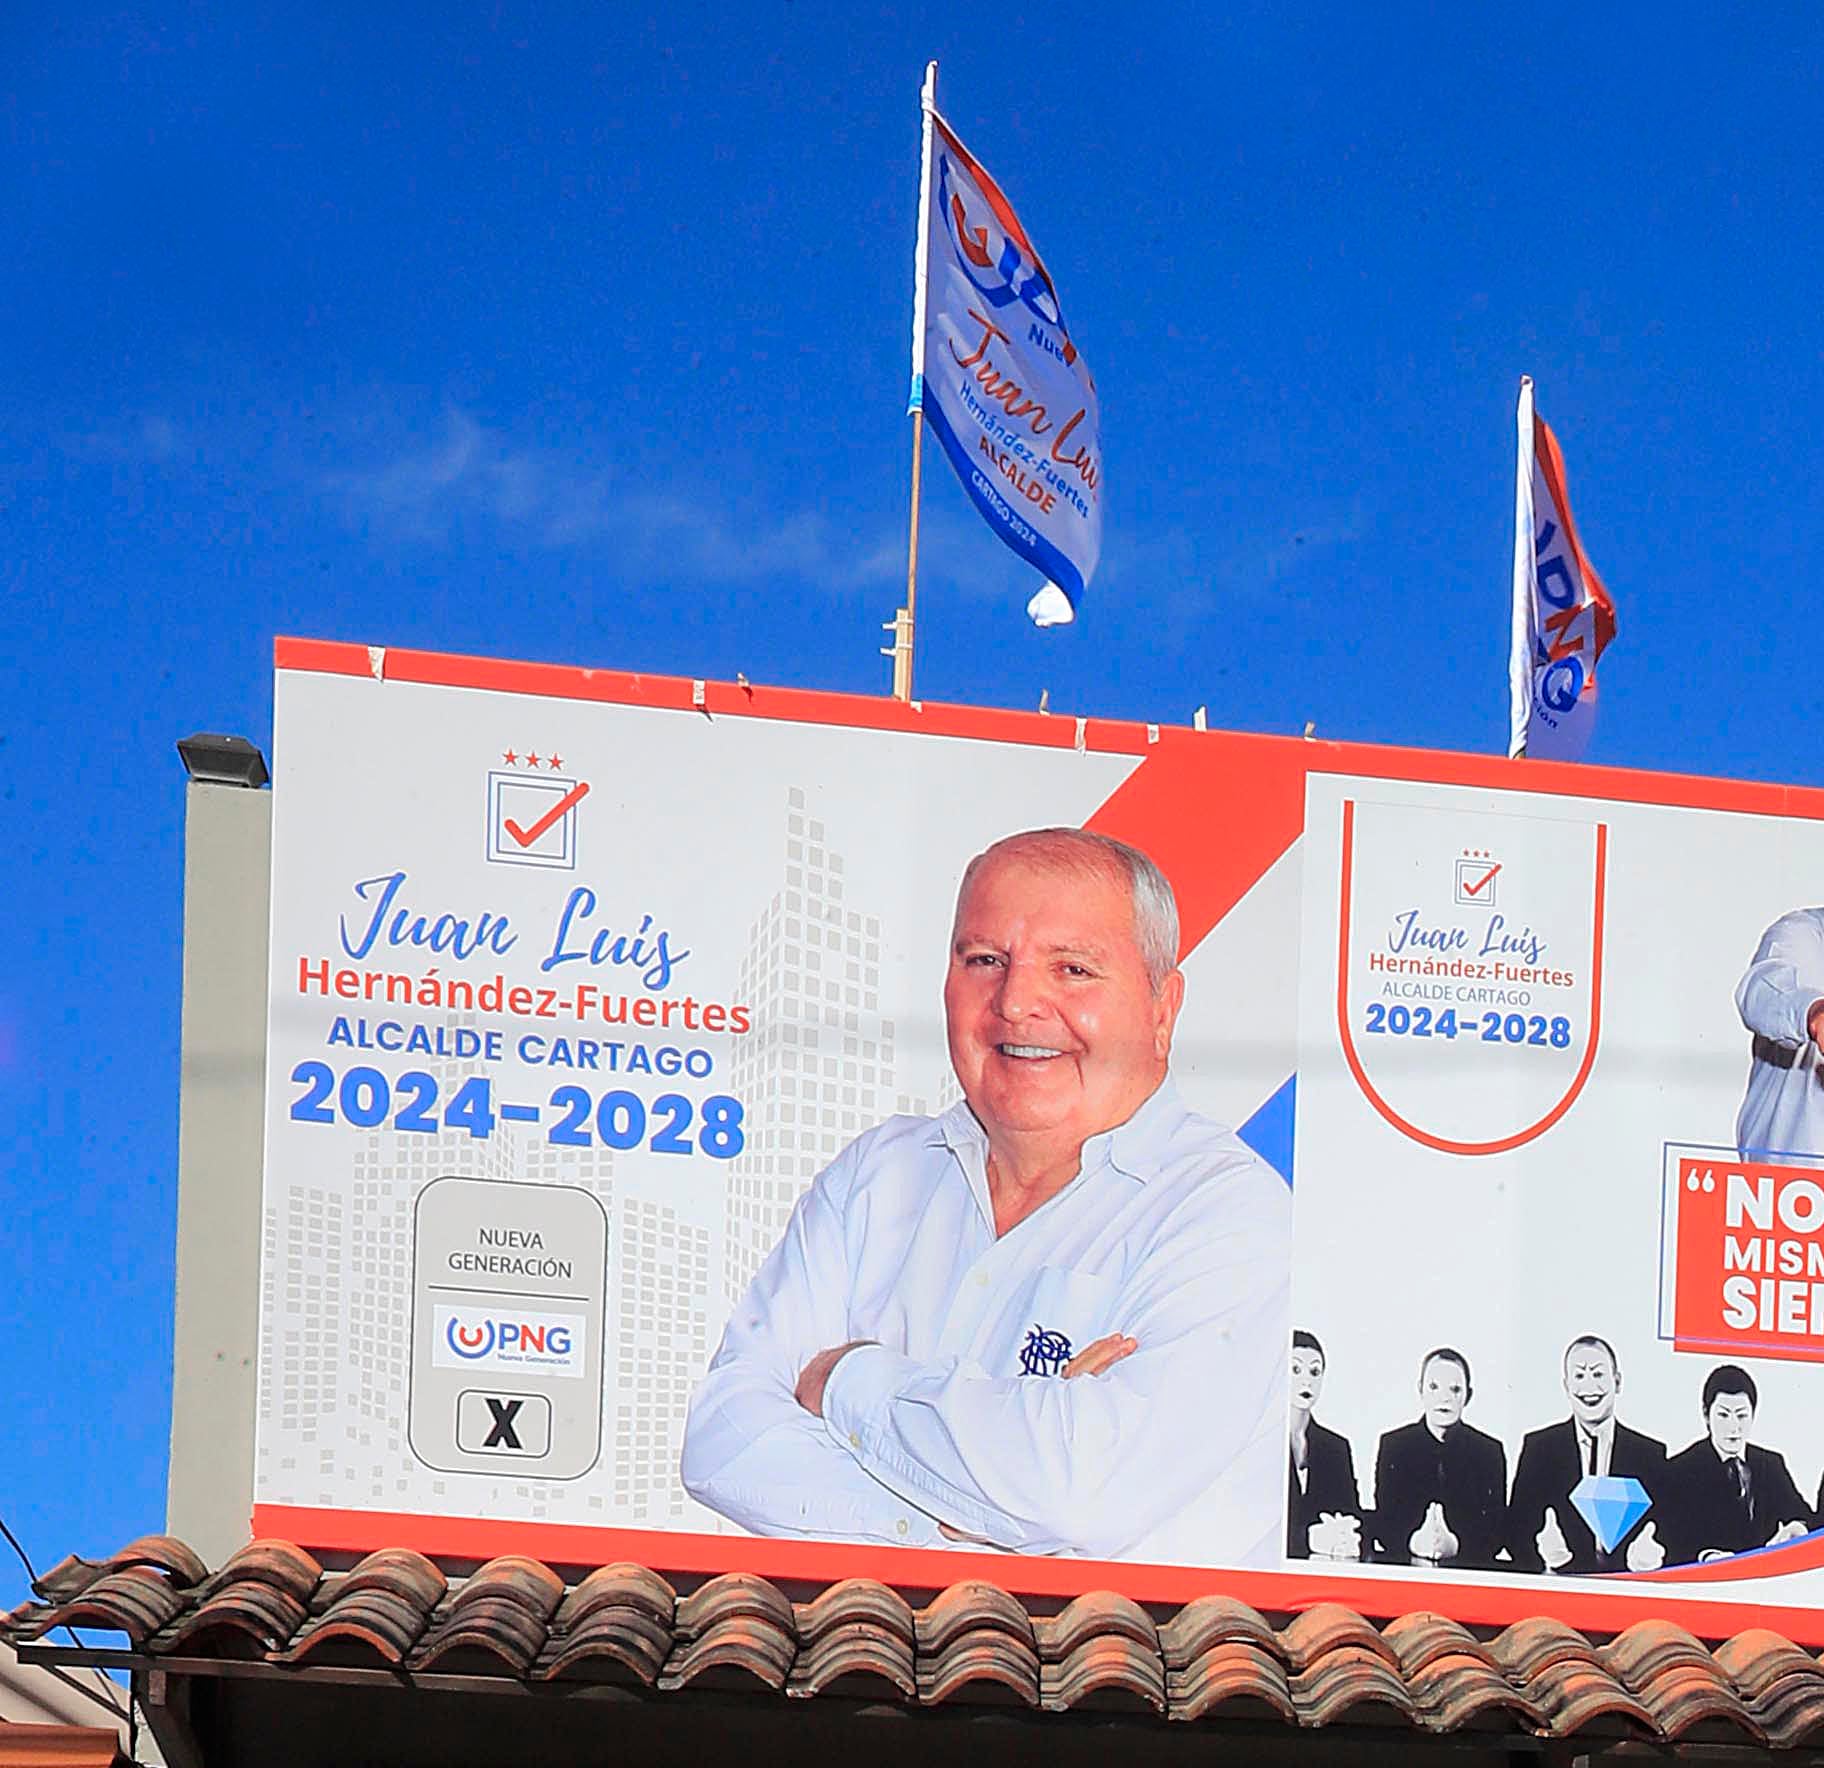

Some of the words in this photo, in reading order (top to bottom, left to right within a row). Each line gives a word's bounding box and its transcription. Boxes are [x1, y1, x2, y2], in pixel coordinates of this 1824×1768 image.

[949, 307, 1053, 434] Juan
[979, 434, 1057, 515] ALCALDE
[339, 872, 519, 962] Juan
[541, 887, 691, 991] Luis
[1388, 909, 1470, 954] Juan
[1478, 914, 1548, 965] Luis
[298, 957, 751, 1034] Hernández-Fuertes
[1368, 952, 1575, 987] Hernández-Fuertes
[1382, 981, 1453, 1001] ALCALDE
[1456, 986, 1532, 1007] CARTAGO
[326, 1016, 504, 1062] ALCALDE
[518, 1033, 714, 1079] CARTAGO
[1365, 1003, 1571, 1049] 2024-2028
[290, 1060, 746, 1160] 2024-2028
[448, 1252, 573, 1279] GENERACIÓN
[479, 1228, 544, 1250] NUEVA
[482, 1397, 524, 1450] X
